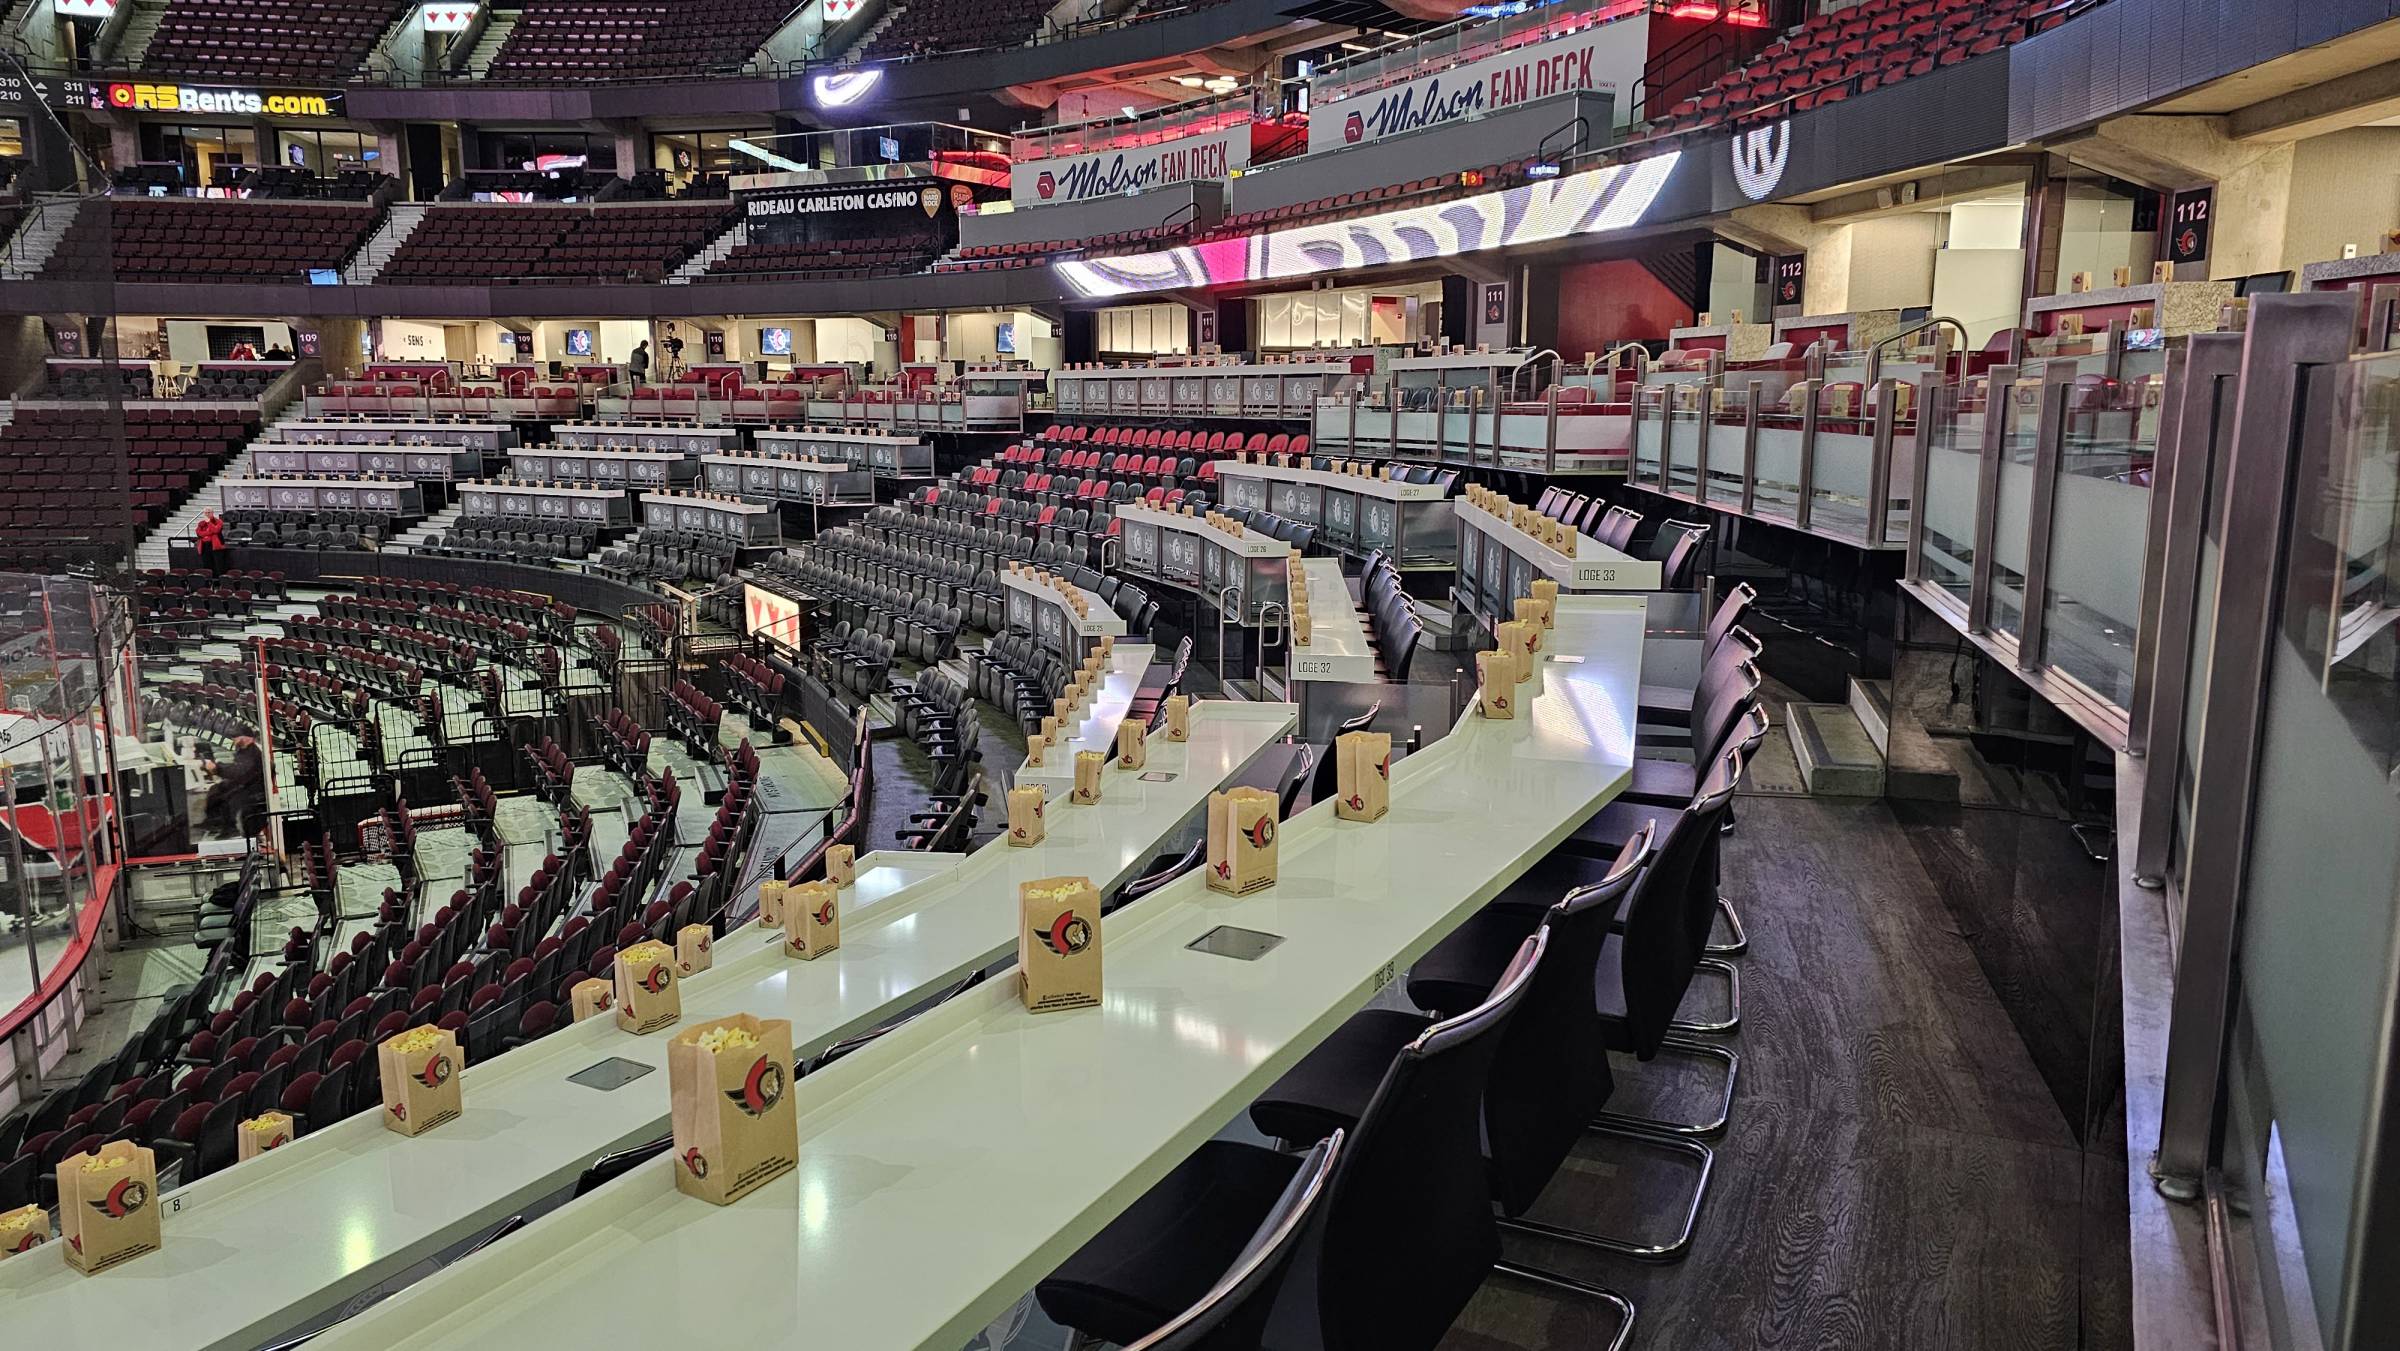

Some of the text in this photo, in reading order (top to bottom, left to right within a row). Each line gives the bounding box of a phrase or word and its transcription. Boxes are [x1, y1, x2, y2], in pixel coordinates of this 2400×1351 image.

[0, 78, 20, 88] 310
[64, 82, 83, 92] 311
[0, 91, 21, 101] 210
[1367, 46, 1595, 137] Molson FAN DECK
[65, 95, 84, 105] 211
[1058, 141, 1227, 200] Molson FAN DECK
[748, 199, 794, 216] RIDEAU
[797, 194, 864, 213] CARLETON
[2177, 200, 2207, 223] 112
[1781, 262, 1801, 277] 112
[1488, 290, 1502, 302] 111
[57, 331, 78, 340] 109
[300, 334, 317, 342] 109
[408, 335, 424, 347] SENS
[518, 335, 531, 343] 109
[711, 335, 722, 343] 110
[1579, 569, 1615, 581] LOGE 33
[1298, 662, 1331, 673] LOGE 32
